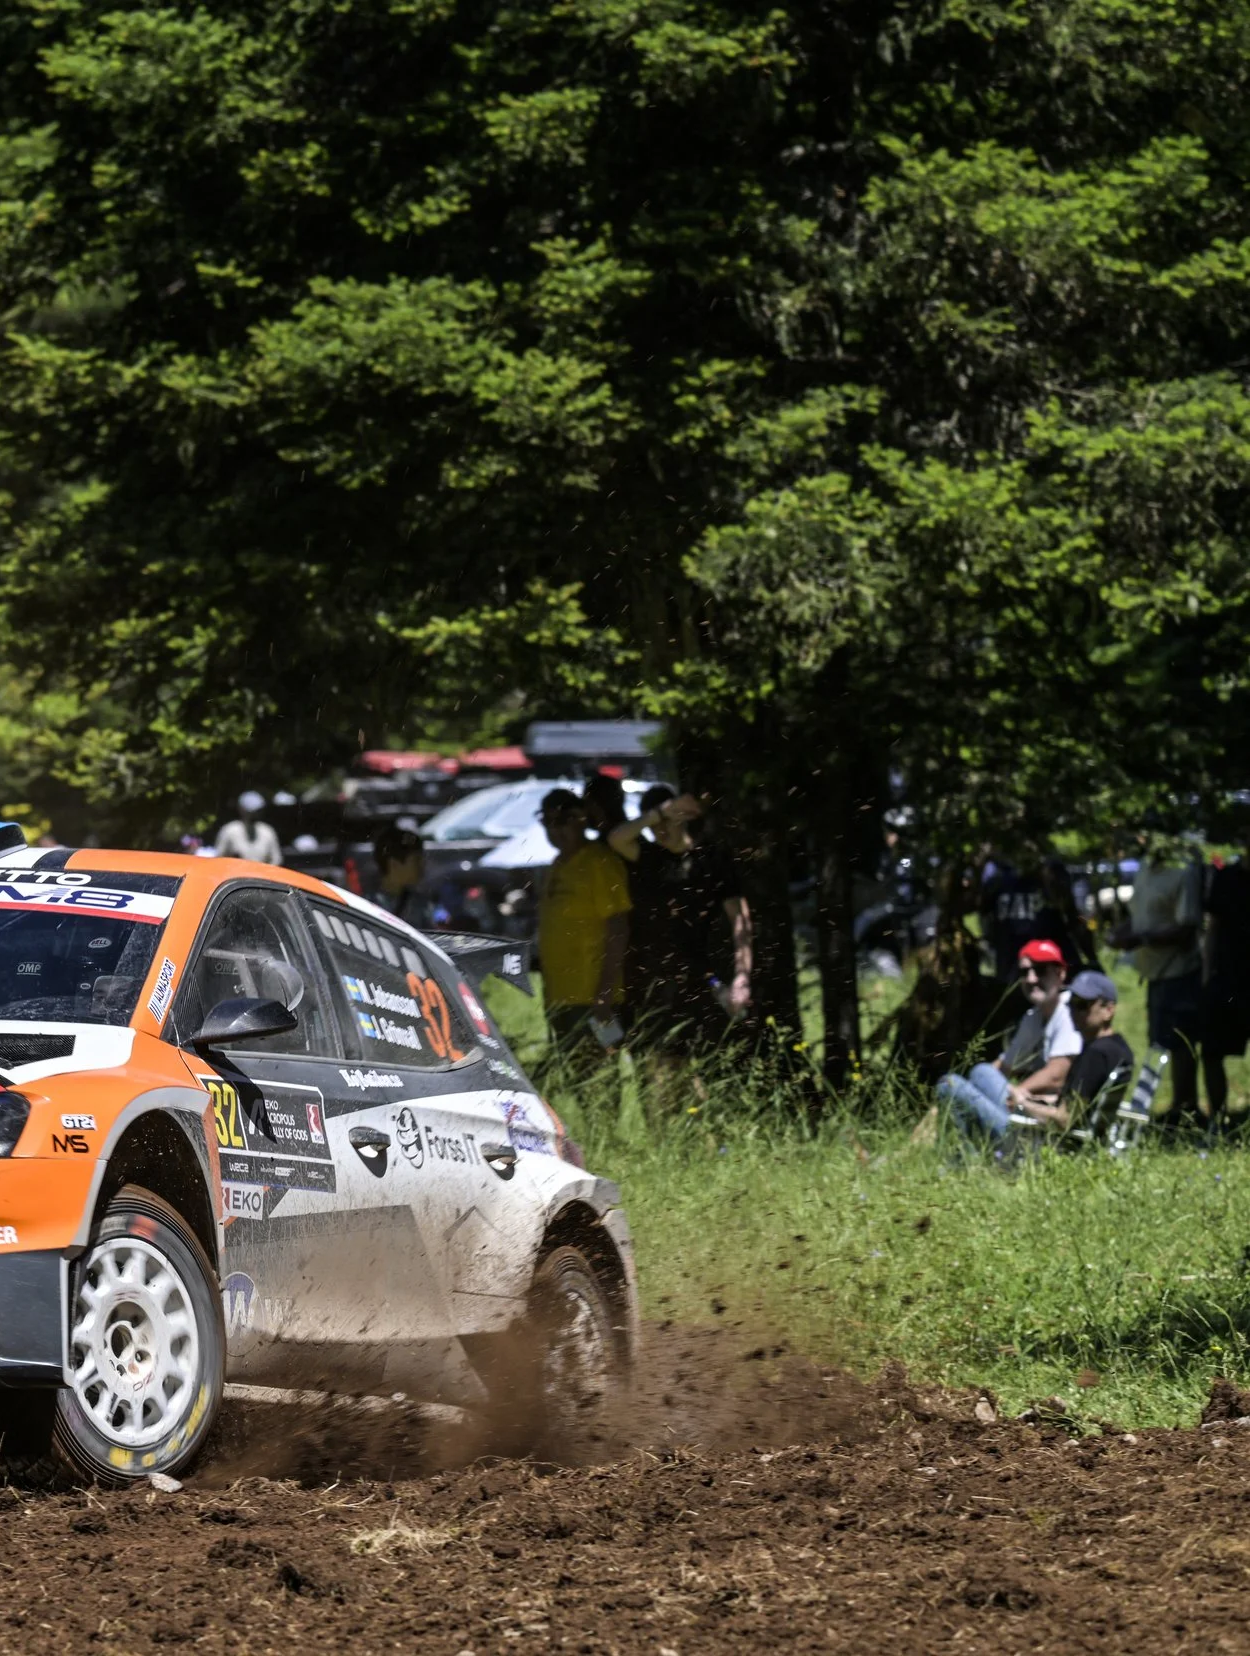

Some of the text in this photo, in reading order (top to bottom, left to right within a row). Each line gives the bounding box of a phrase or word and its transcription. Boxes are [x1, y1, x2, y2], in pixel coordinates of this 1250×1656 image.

[17, 963, 42, 973] OMP
[153, 958, 176, 1004] ALMASPORT
[406, 971, 464, 1062] 32
[207, 1081, 244, 1147] 32
[265, 1099, 279, 1110] EKO
[52, 1133, 90, 1153] MS
[285, 1128, 294, 1139] OF
[293, 1129, 309, 1142] GODS
[425, 1126, 467, 1164] Forss
[462, 1132, 481, 1166] IT
[232, 1190, 262, 1212] EKO
